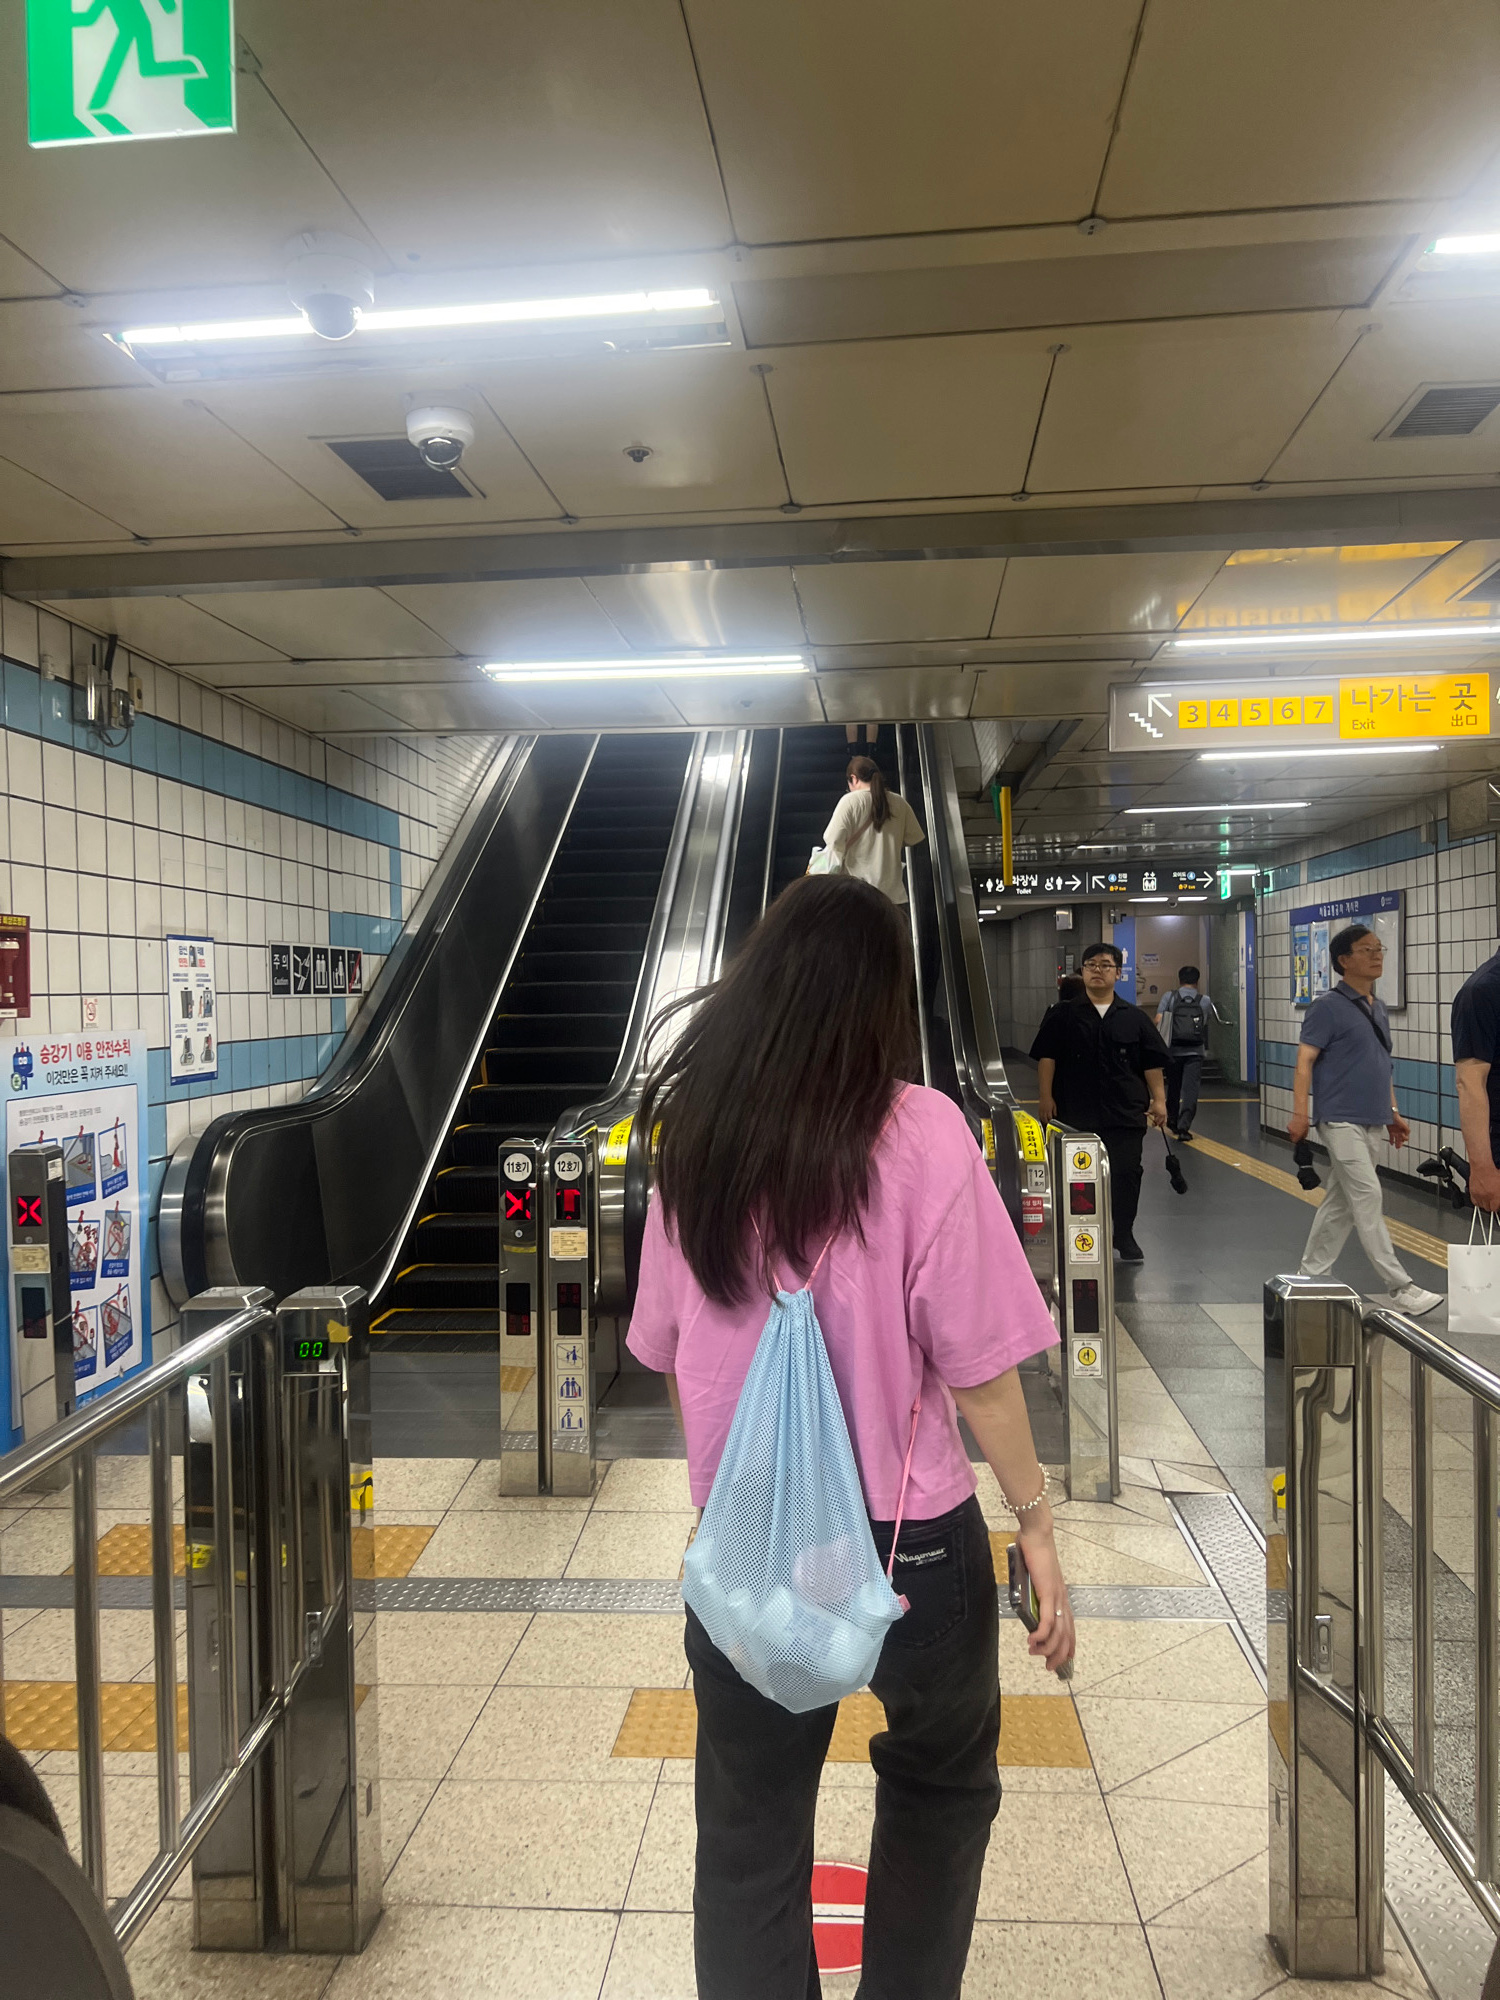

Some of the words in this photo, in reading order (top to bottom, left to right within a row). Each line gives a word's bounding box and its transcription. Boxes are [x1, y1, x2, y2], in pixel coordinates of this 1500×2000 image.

[1352, 683, 1436, 713] 나가는
[1449, 682, 1477, 711] 곳
[1187, 705, 1199, 723] 3
[1216, 703, 1230, 721] 4
[1249, 702, 1261, 720] 5
[1281, 701, 1293, 719] 6
[1314, 700, 1325, 719] 7
[1352, 719, 1376, 730] Exit
[1450, 713, 1478, 727] 出口
[1012, 874, 1038, 886] 화장실
[273, 954, 288, 970] 주의
[274, 977, 288, 985] Caution
[40, 1043, 72, 1064] 승강기
[76, 1042, 92, 1060] 이용
[96, 1039, 131, 1058] 안전수칙
[46, 1068, 78, 1085] 이것만은
[81, 1066, 88, 1082] 꼭
[90, 1066, 103, 1080] 지켜
[507, 1161, 529, 1173] 11호기
[557, 1160, 580, 1173] 12호기
[1034, 1170, 1044, 1178] 12
[299, 1342, 322, 1357] 00
